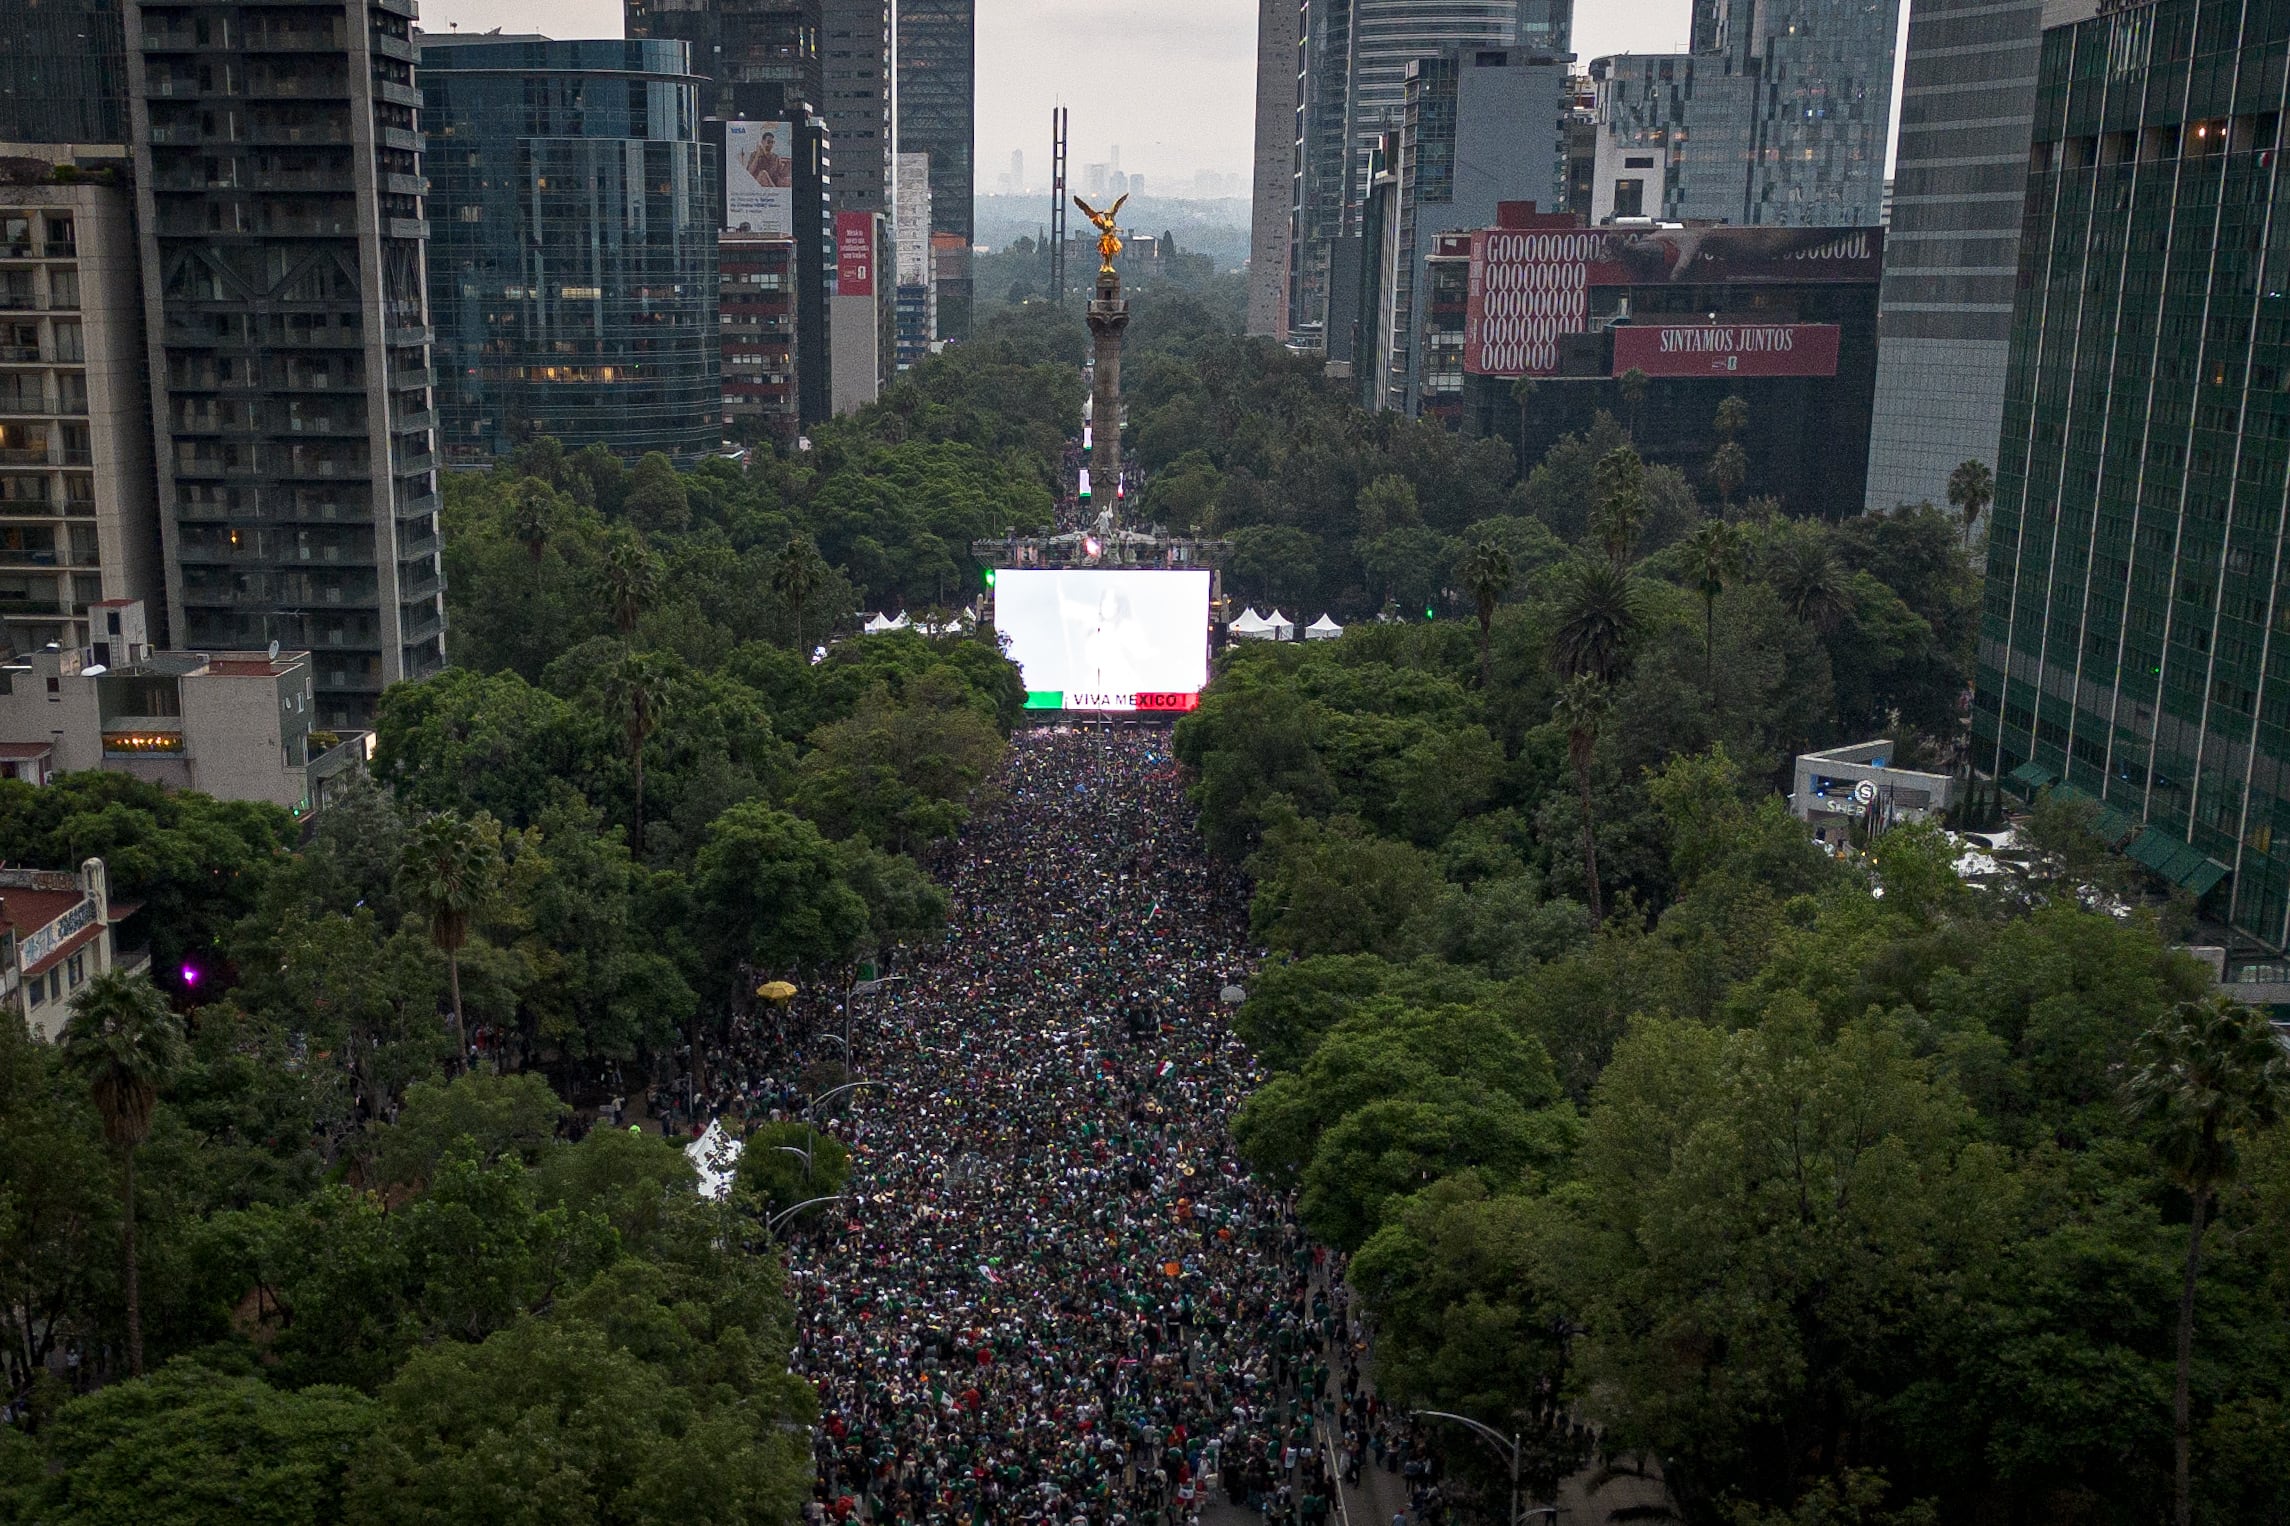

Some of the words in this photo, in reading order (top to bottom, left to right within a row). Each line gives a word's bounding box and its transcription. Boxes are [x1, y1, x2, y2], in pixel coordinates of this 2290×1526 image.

[1660, 329, 1734, 352] SINTAMOS
[1736, 328, 1793, 351] JUNTOS
[1074, 693, 1110, 706] VIVA
[1115, 693, 1177, 707] MEXICO
